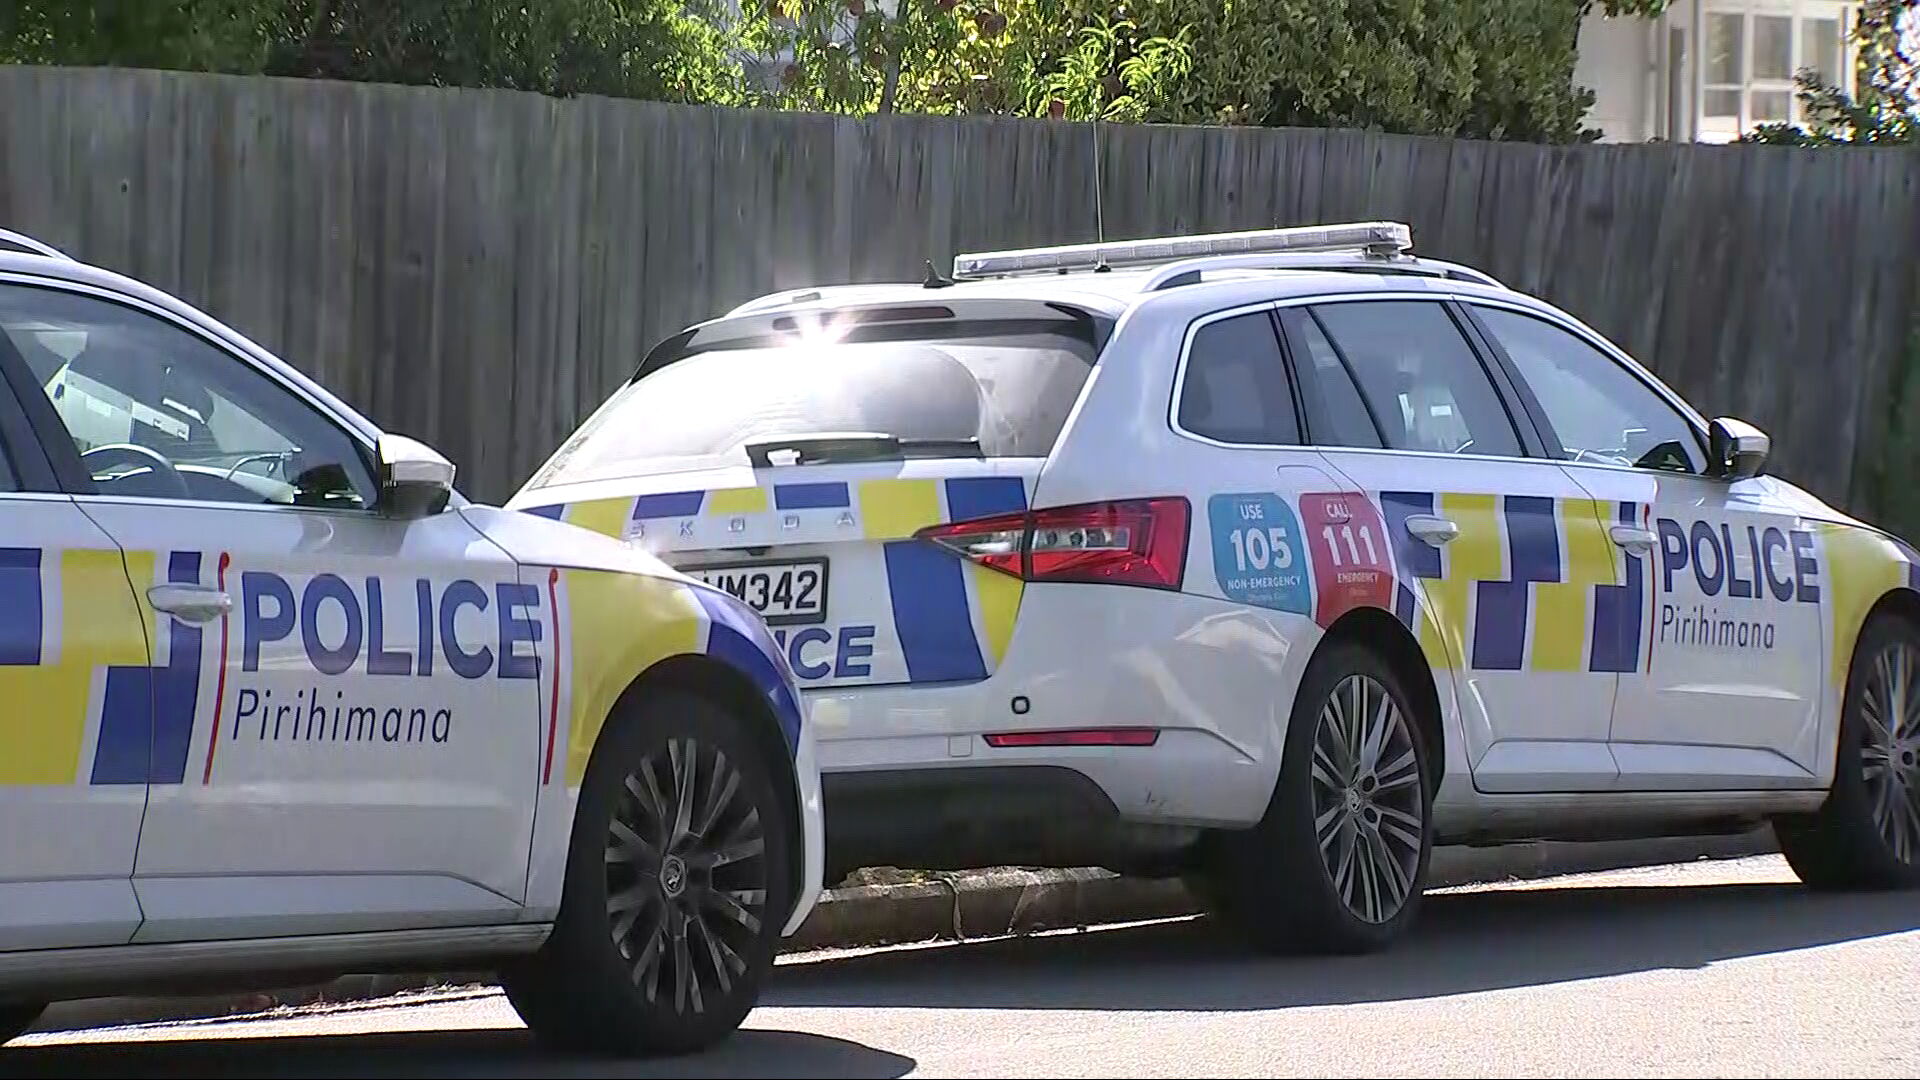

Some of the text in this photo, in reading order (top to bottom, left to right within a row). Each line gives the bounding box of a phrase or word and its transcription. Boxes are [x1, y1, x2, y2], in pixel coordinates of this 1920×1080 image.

[1239, 503, 1264, 520] USE
[1326, 503, 1353, 519] CALL
[1229, 526, 1293, 572] 105
[1322, 525, 1378, 567] 111
[1656, 517, 1821, 604] POLICE
[1227, 575, 1301, 591] NON-EMERGENCY
[1336, 571, 1379, 584] EMERGENCY
[241, 571, 543, 680] POLICE
[1660, 603, 1776, 650] Pirihimana
[232, 688, 452, 744] Pirihimana
